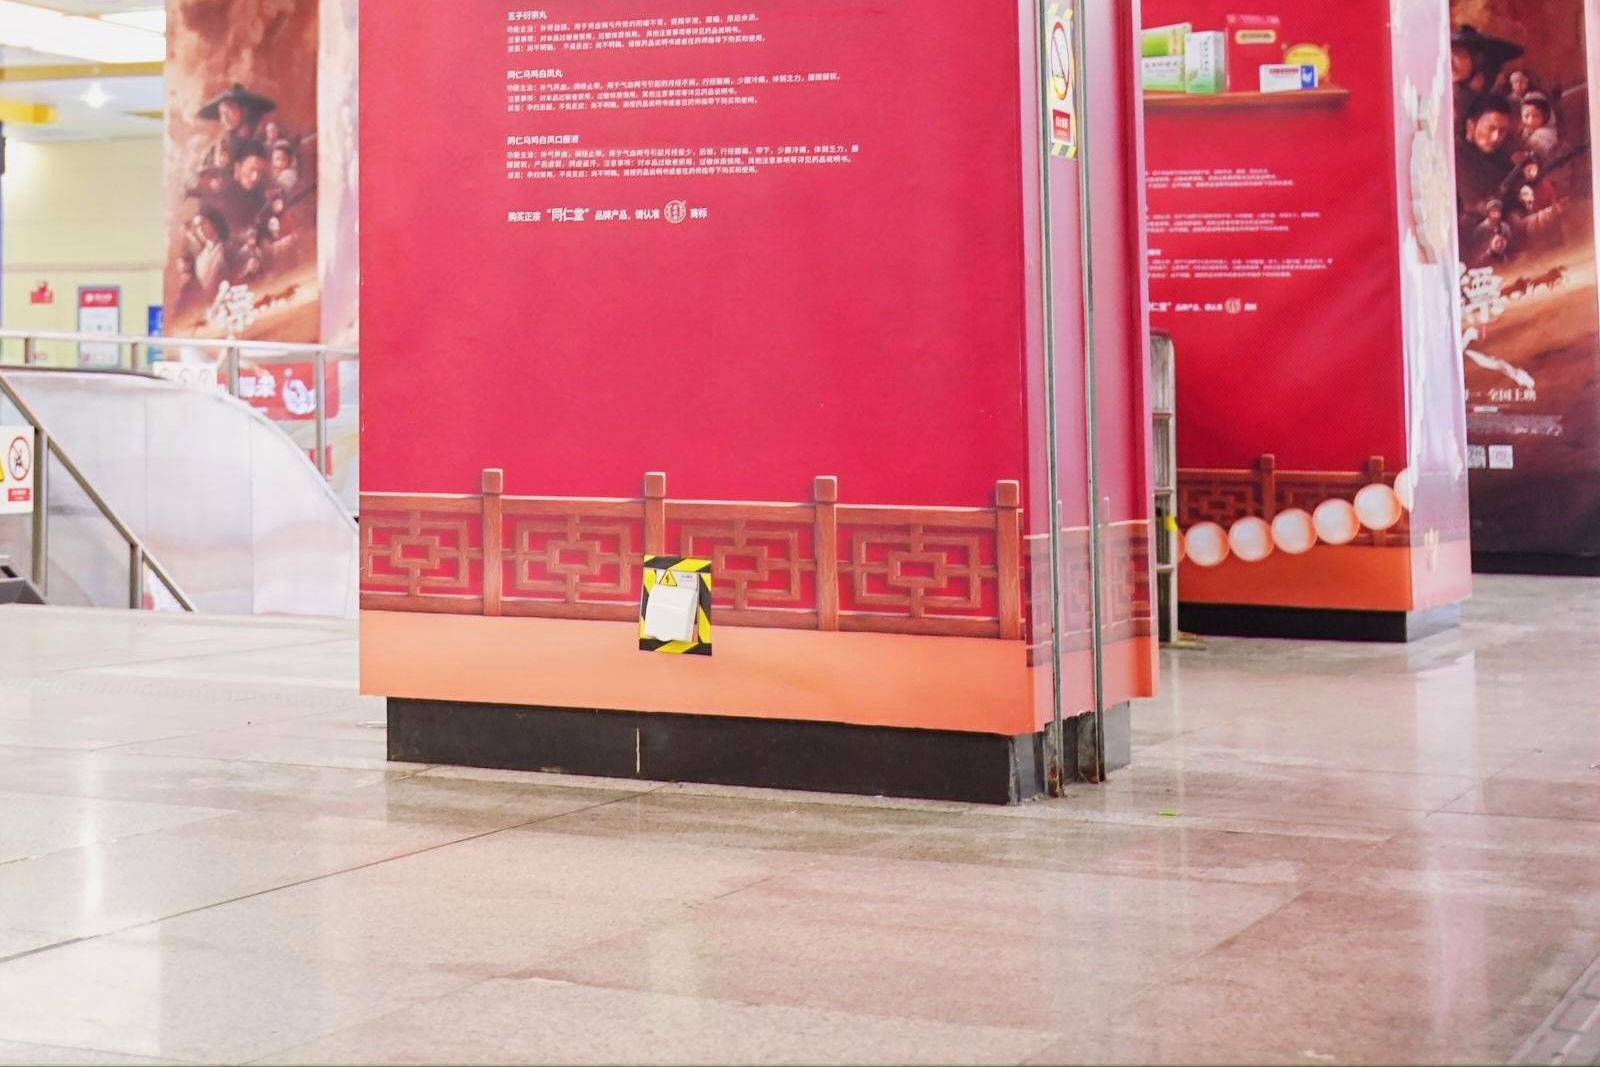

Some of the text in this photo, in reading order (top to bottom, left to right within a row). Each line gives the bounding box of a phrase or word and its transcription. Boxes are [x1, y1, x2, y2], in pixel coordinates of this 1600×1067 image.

[507, 135, 579, 146] 同仁乌鸡白凤口服液
